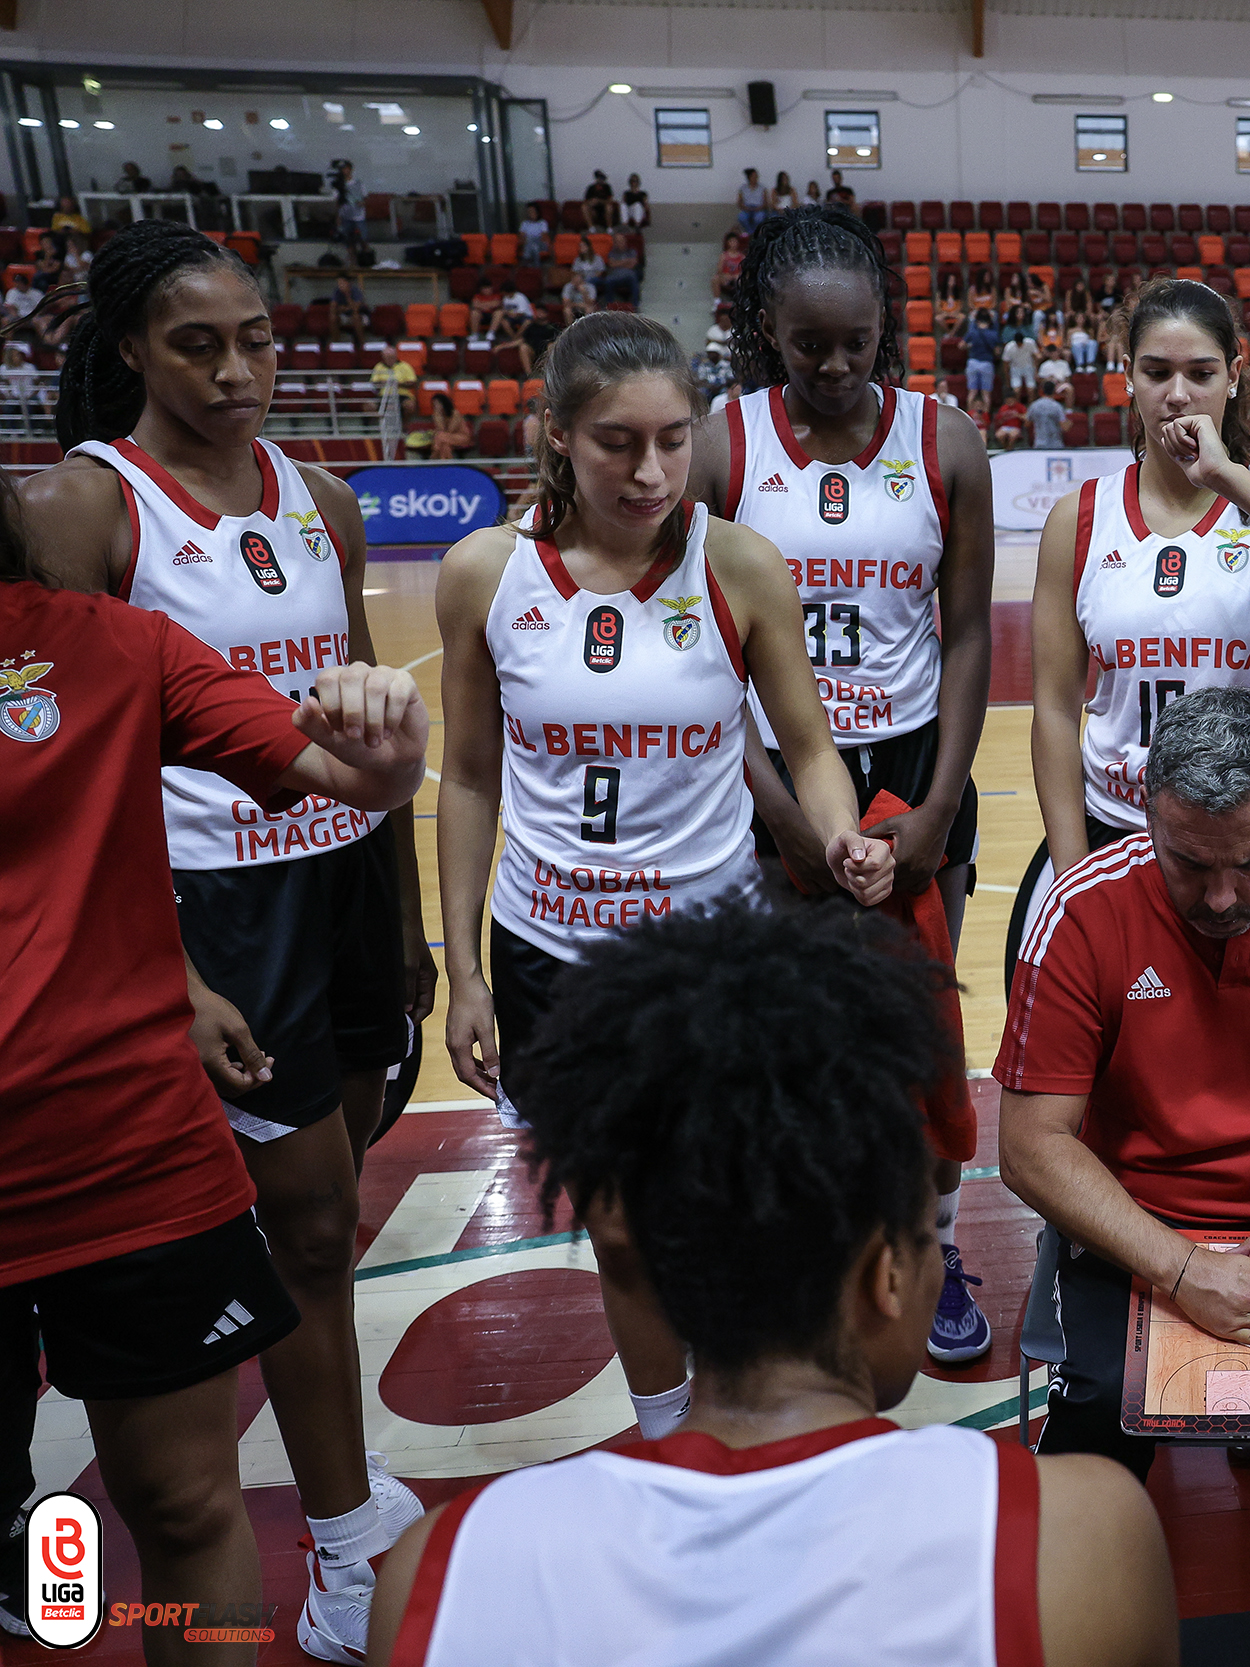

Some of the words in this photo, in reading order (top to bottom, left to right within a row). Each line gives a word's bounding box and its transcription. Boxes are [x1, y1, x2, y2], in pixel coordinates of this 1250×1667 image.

[758, 485, 789, 493] adidas
[389, 488, 482, 525] skoiy
[172, 554, 213, 566] adidas
[1100, 561, 1127, 570] didas
[511, 621, 550, 630] adidas
[802, 603, 861, 667] 33
[229, 633, 349, 676] BENFIC
[817, 677, 893, 701] OBAL
[824, 702, 893, 731] GEM
[542, 720, 722, 759] BENFICA
[581, 765, 621, 844] 9
[234, 810, 372, 862] IMAGEM
[529, 890, 671, 929] IMAGEM
[1126, 988, 1172, 1000] adidas
